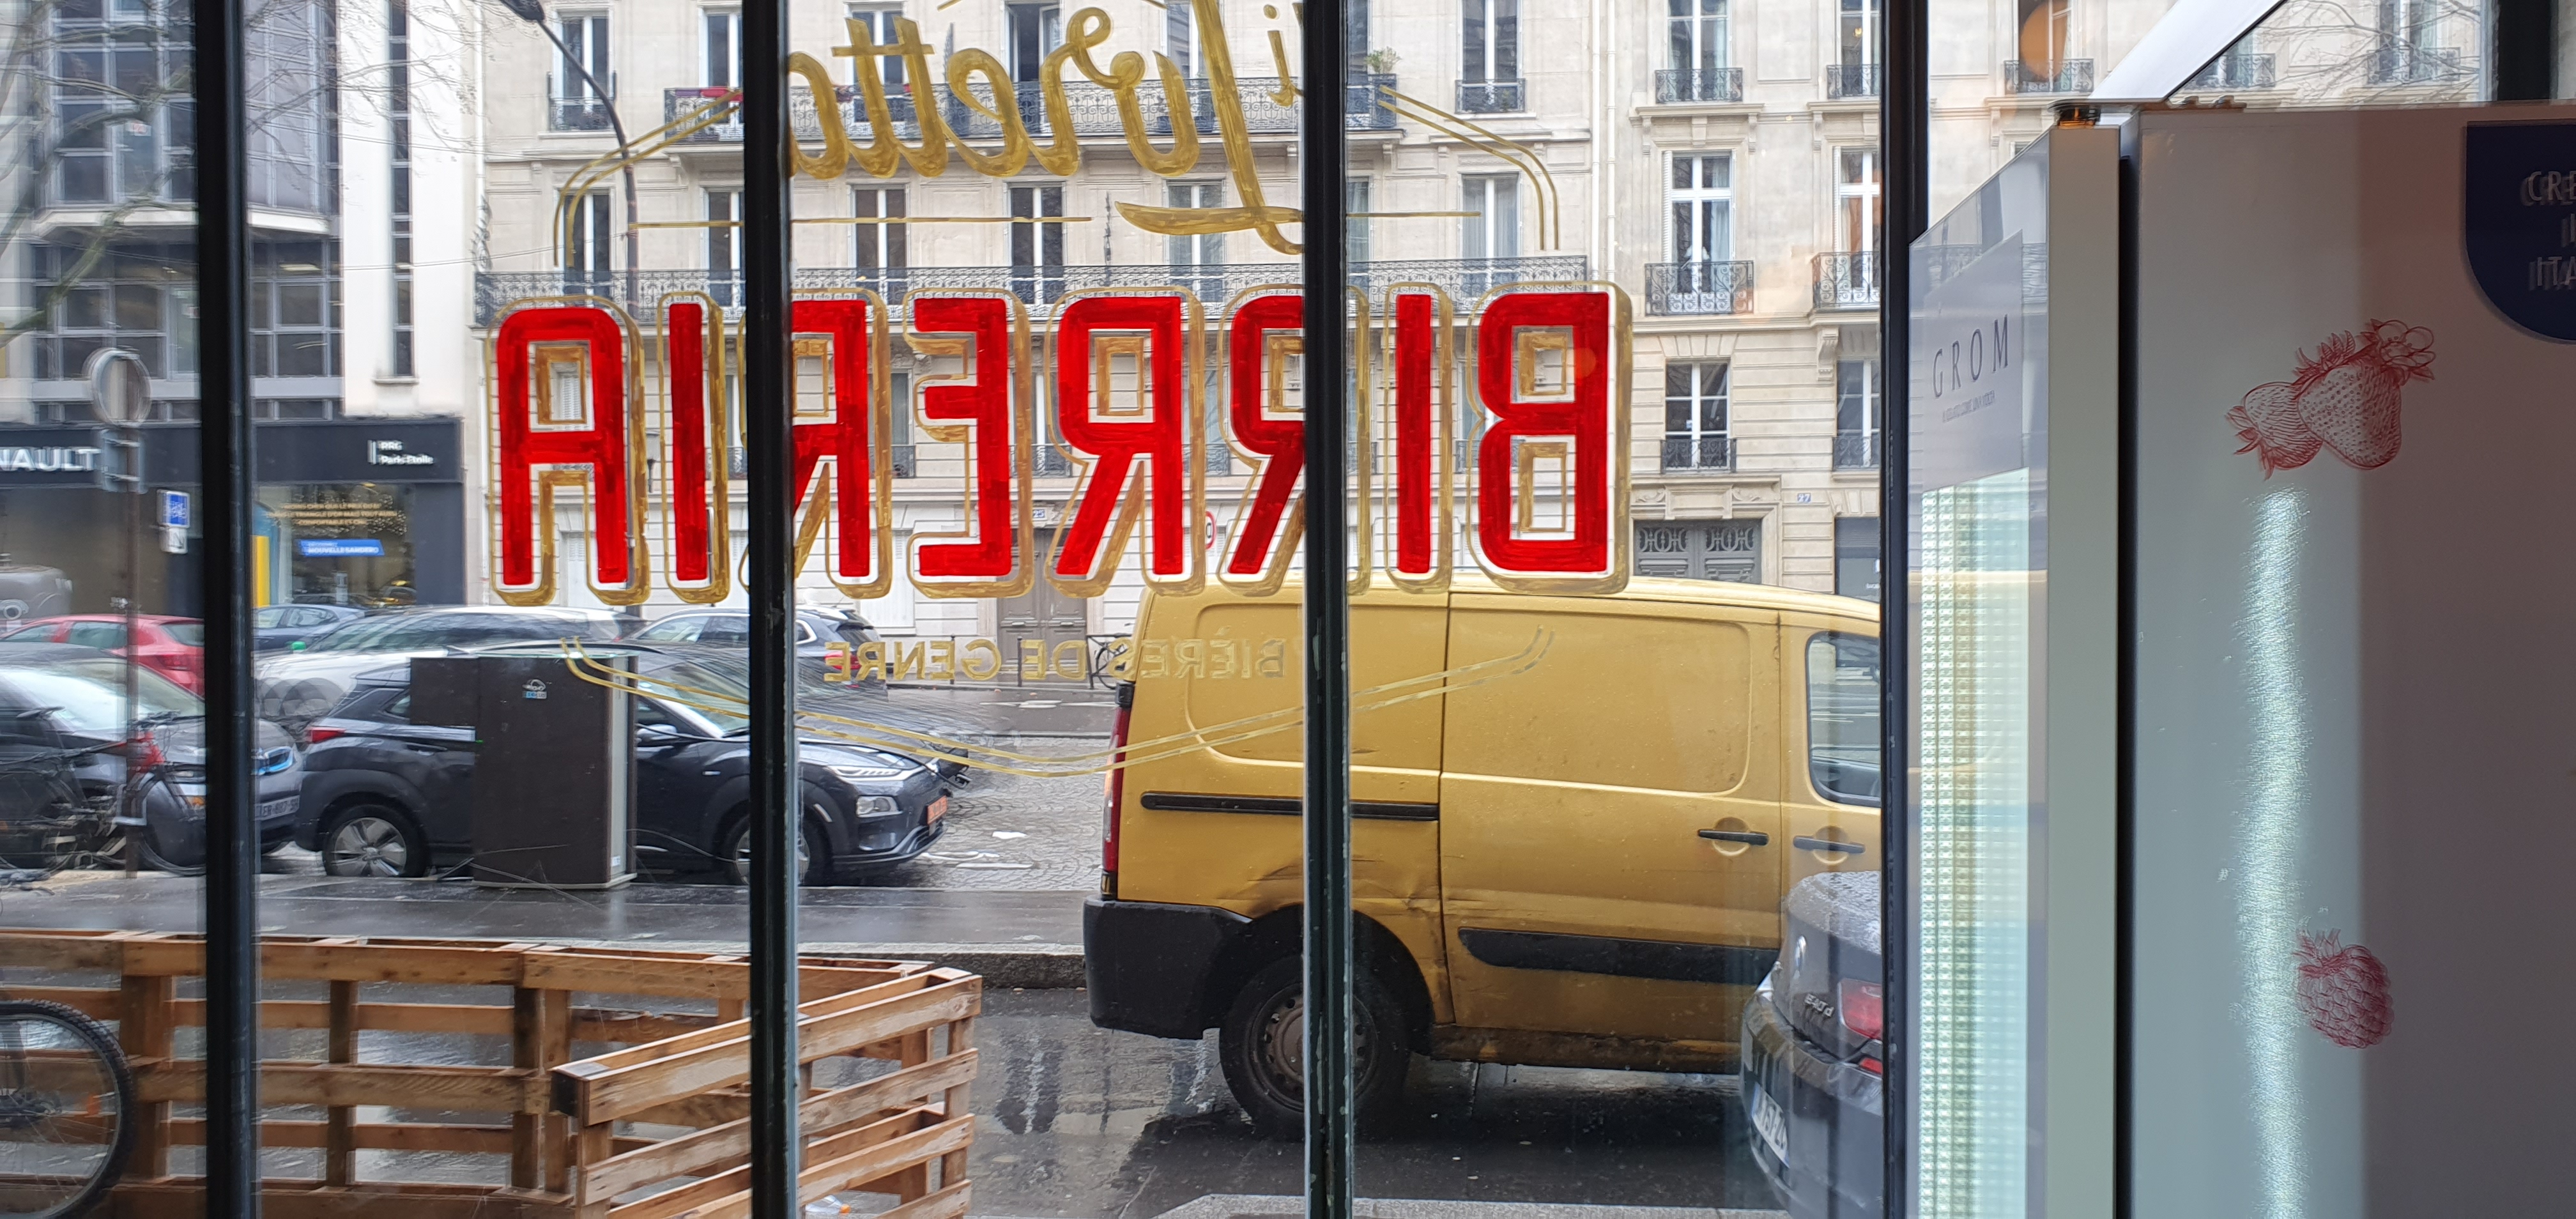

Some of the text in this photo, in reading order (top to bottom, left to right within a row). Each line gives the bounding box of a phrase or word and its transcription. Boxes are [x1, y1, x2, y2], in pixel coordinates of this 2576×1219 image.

[1933, 314, 2009, 399] GROM
[378, 454, 405, 464] Paris
[1798, 493, 1811, 502] 27
